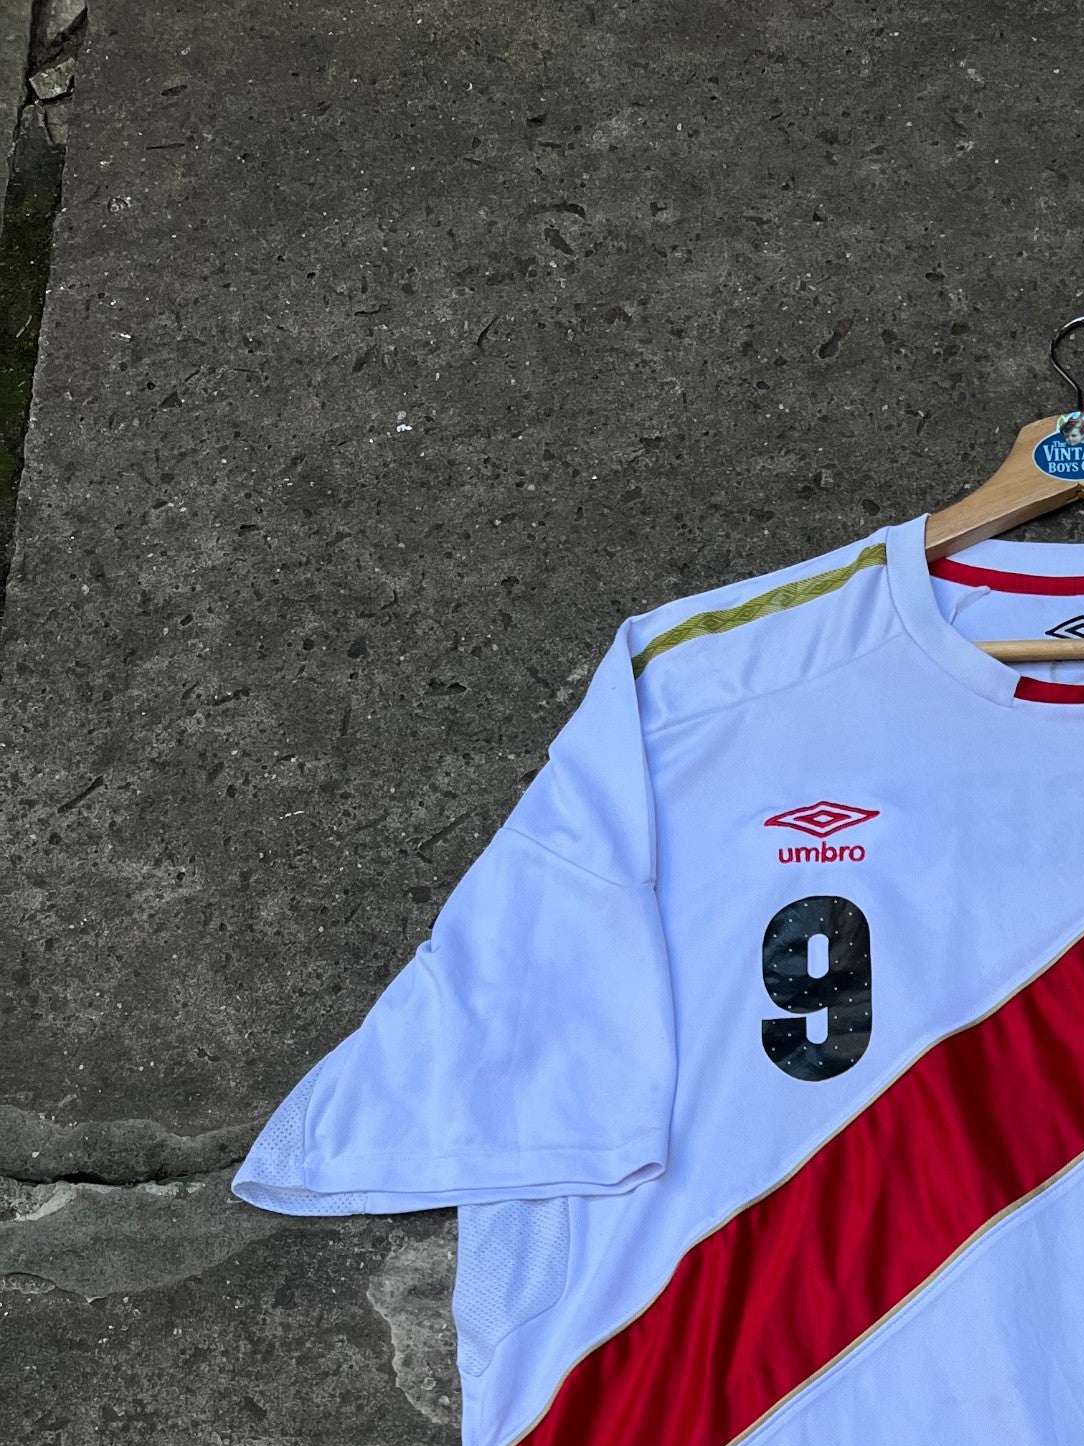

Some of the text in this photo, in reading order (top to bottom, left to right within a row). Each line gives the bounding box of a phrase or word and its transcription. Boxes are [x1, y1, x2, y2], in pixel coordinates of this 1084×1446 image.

[1048, 462, 1079, 473] BOYS
[778, 841, 866, 864] umbro
[761, 895, 873, 1082] 9
